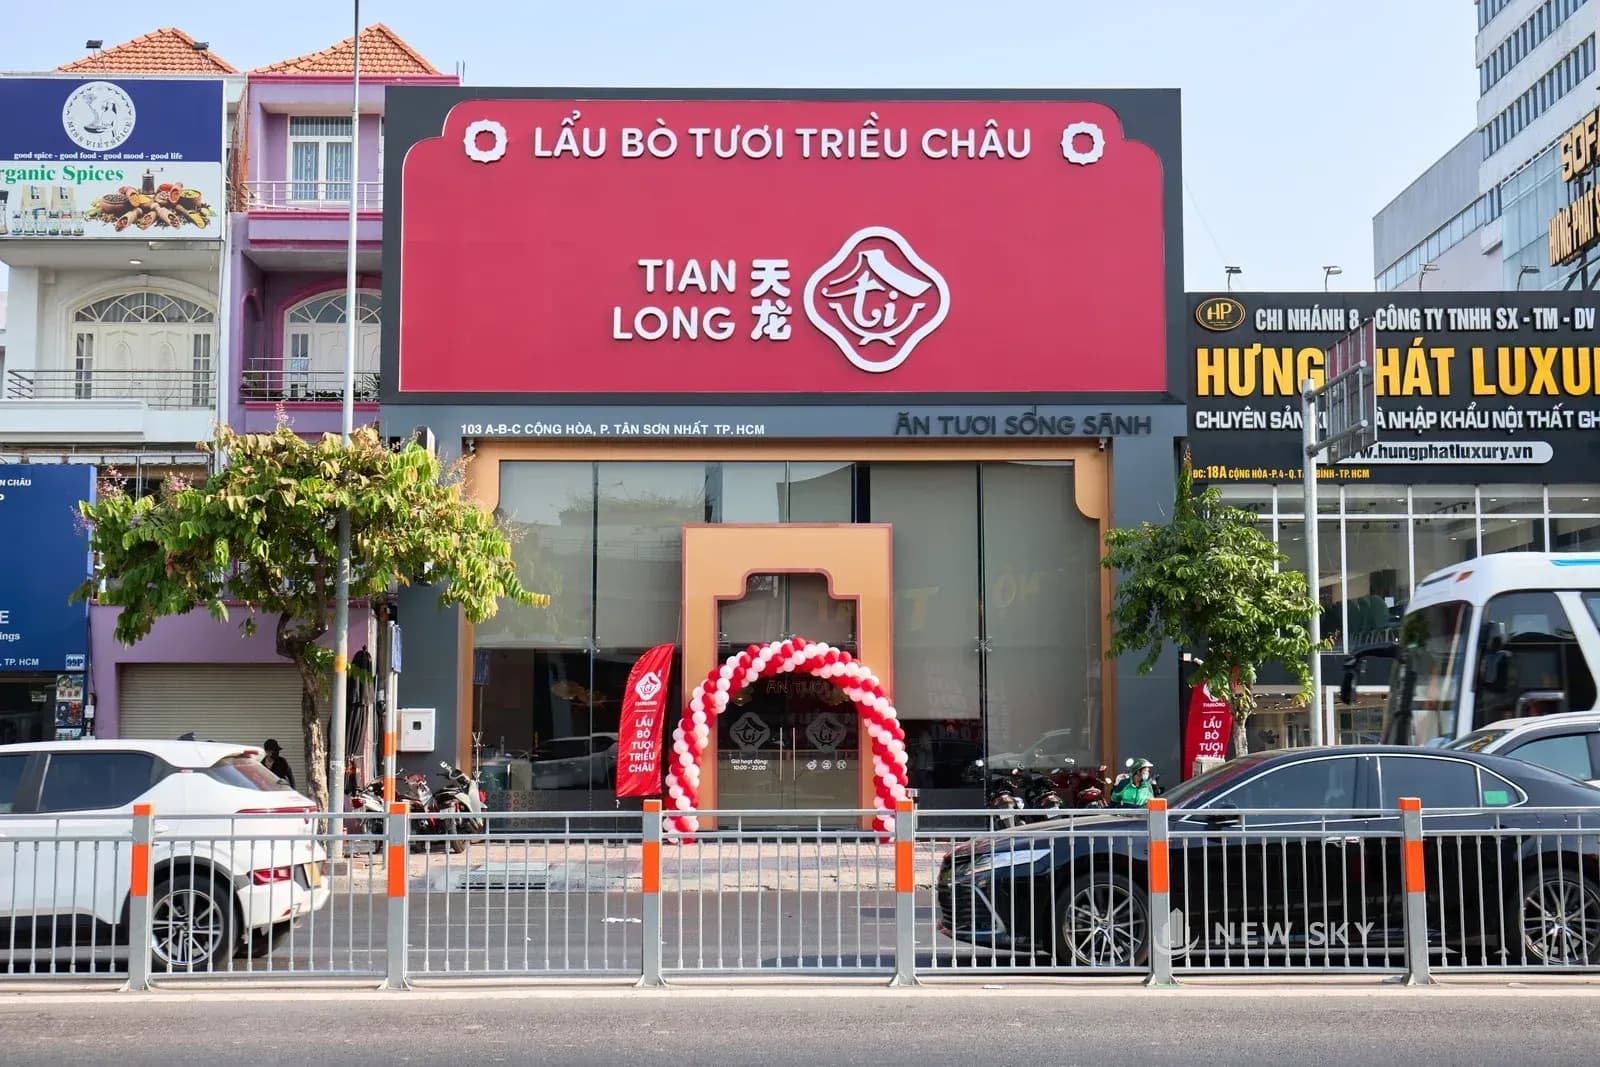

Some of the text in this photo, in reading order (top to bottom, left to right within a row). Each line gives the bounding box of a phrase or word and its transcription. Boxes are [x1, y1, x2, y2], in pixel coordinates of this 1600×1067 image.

[534, 109, 1031, 159] LẨU BÒ TƯƠI TRIỀU CHÂU
[1560, 108, 1600, 184] SOF
[14, 152, 32, 160] good
[34, 152, 53, 160] spice
[60, 152, 78, 160] good
[103, 152, 122, 160] good
[151, 153, 169, 161] good
[63, 164, 124, 184] Spices
[638, 258, 737, 293] TIAN
[1207, 303, 1233, 320] HP
[1255, 309, 1283, 331] CHI
[1287, 305, 1345, 332] NHÁNH
[1375, 304, 1421, 330] CÔNG
[1424, 308, 1443, 330] TY
[1448, 307, 1491, 330] TNHH
[1496, 307, 1519, 330] SX
[1533, 307, 1558, 330] TM
[1574, 307, 1595, 330] DV
[612, 306, 736, 341] LONG
[1196, 343, 1325, 396] HƯNG
[1376, 336, 1455, 395] HÁT
[896, 411, 930, 435] ĂN
[938, 414, 997, 436] TƯƠI
[1005, 405, 1076, 436] SỐNG
[1196, 407, 1266, 429] CHUYÊN
[1389, 406, 1437, 434] NHẬP
[1441, 401, 1489, 429] KHẨU
[1493, 405, 1523, 433] NỘI
[1527, 402, 1574, 429] THẤT
[461, 424, 482, 434] 103
[485, 424, 521, 434] A-B-C
[525, 422, 561, 436] CỘNG
[566, 421, 597, 436] HÒA,
[601, 424, 610, 434] P.
[614, 422, 640, 434] TÂN
[643, 424, 670, 435] SƠN
[674, 420, 709, 435] NHẤT
[1207, 466, 1227, 478] 18A
[1229, 469, 1250, 480] CỘNG
[1252, 467, 1267, 478] HÒA
[7, 478, 31, 486] CHÂU
[635, 715, 653, 727] LẨU
[1203, 716, 1222, 728] LẨU
[637, 729, 651, 738] BÒ
[1205, 730, 1219, 739] BÒ
[629, 763, 654, 772] CHÂU
